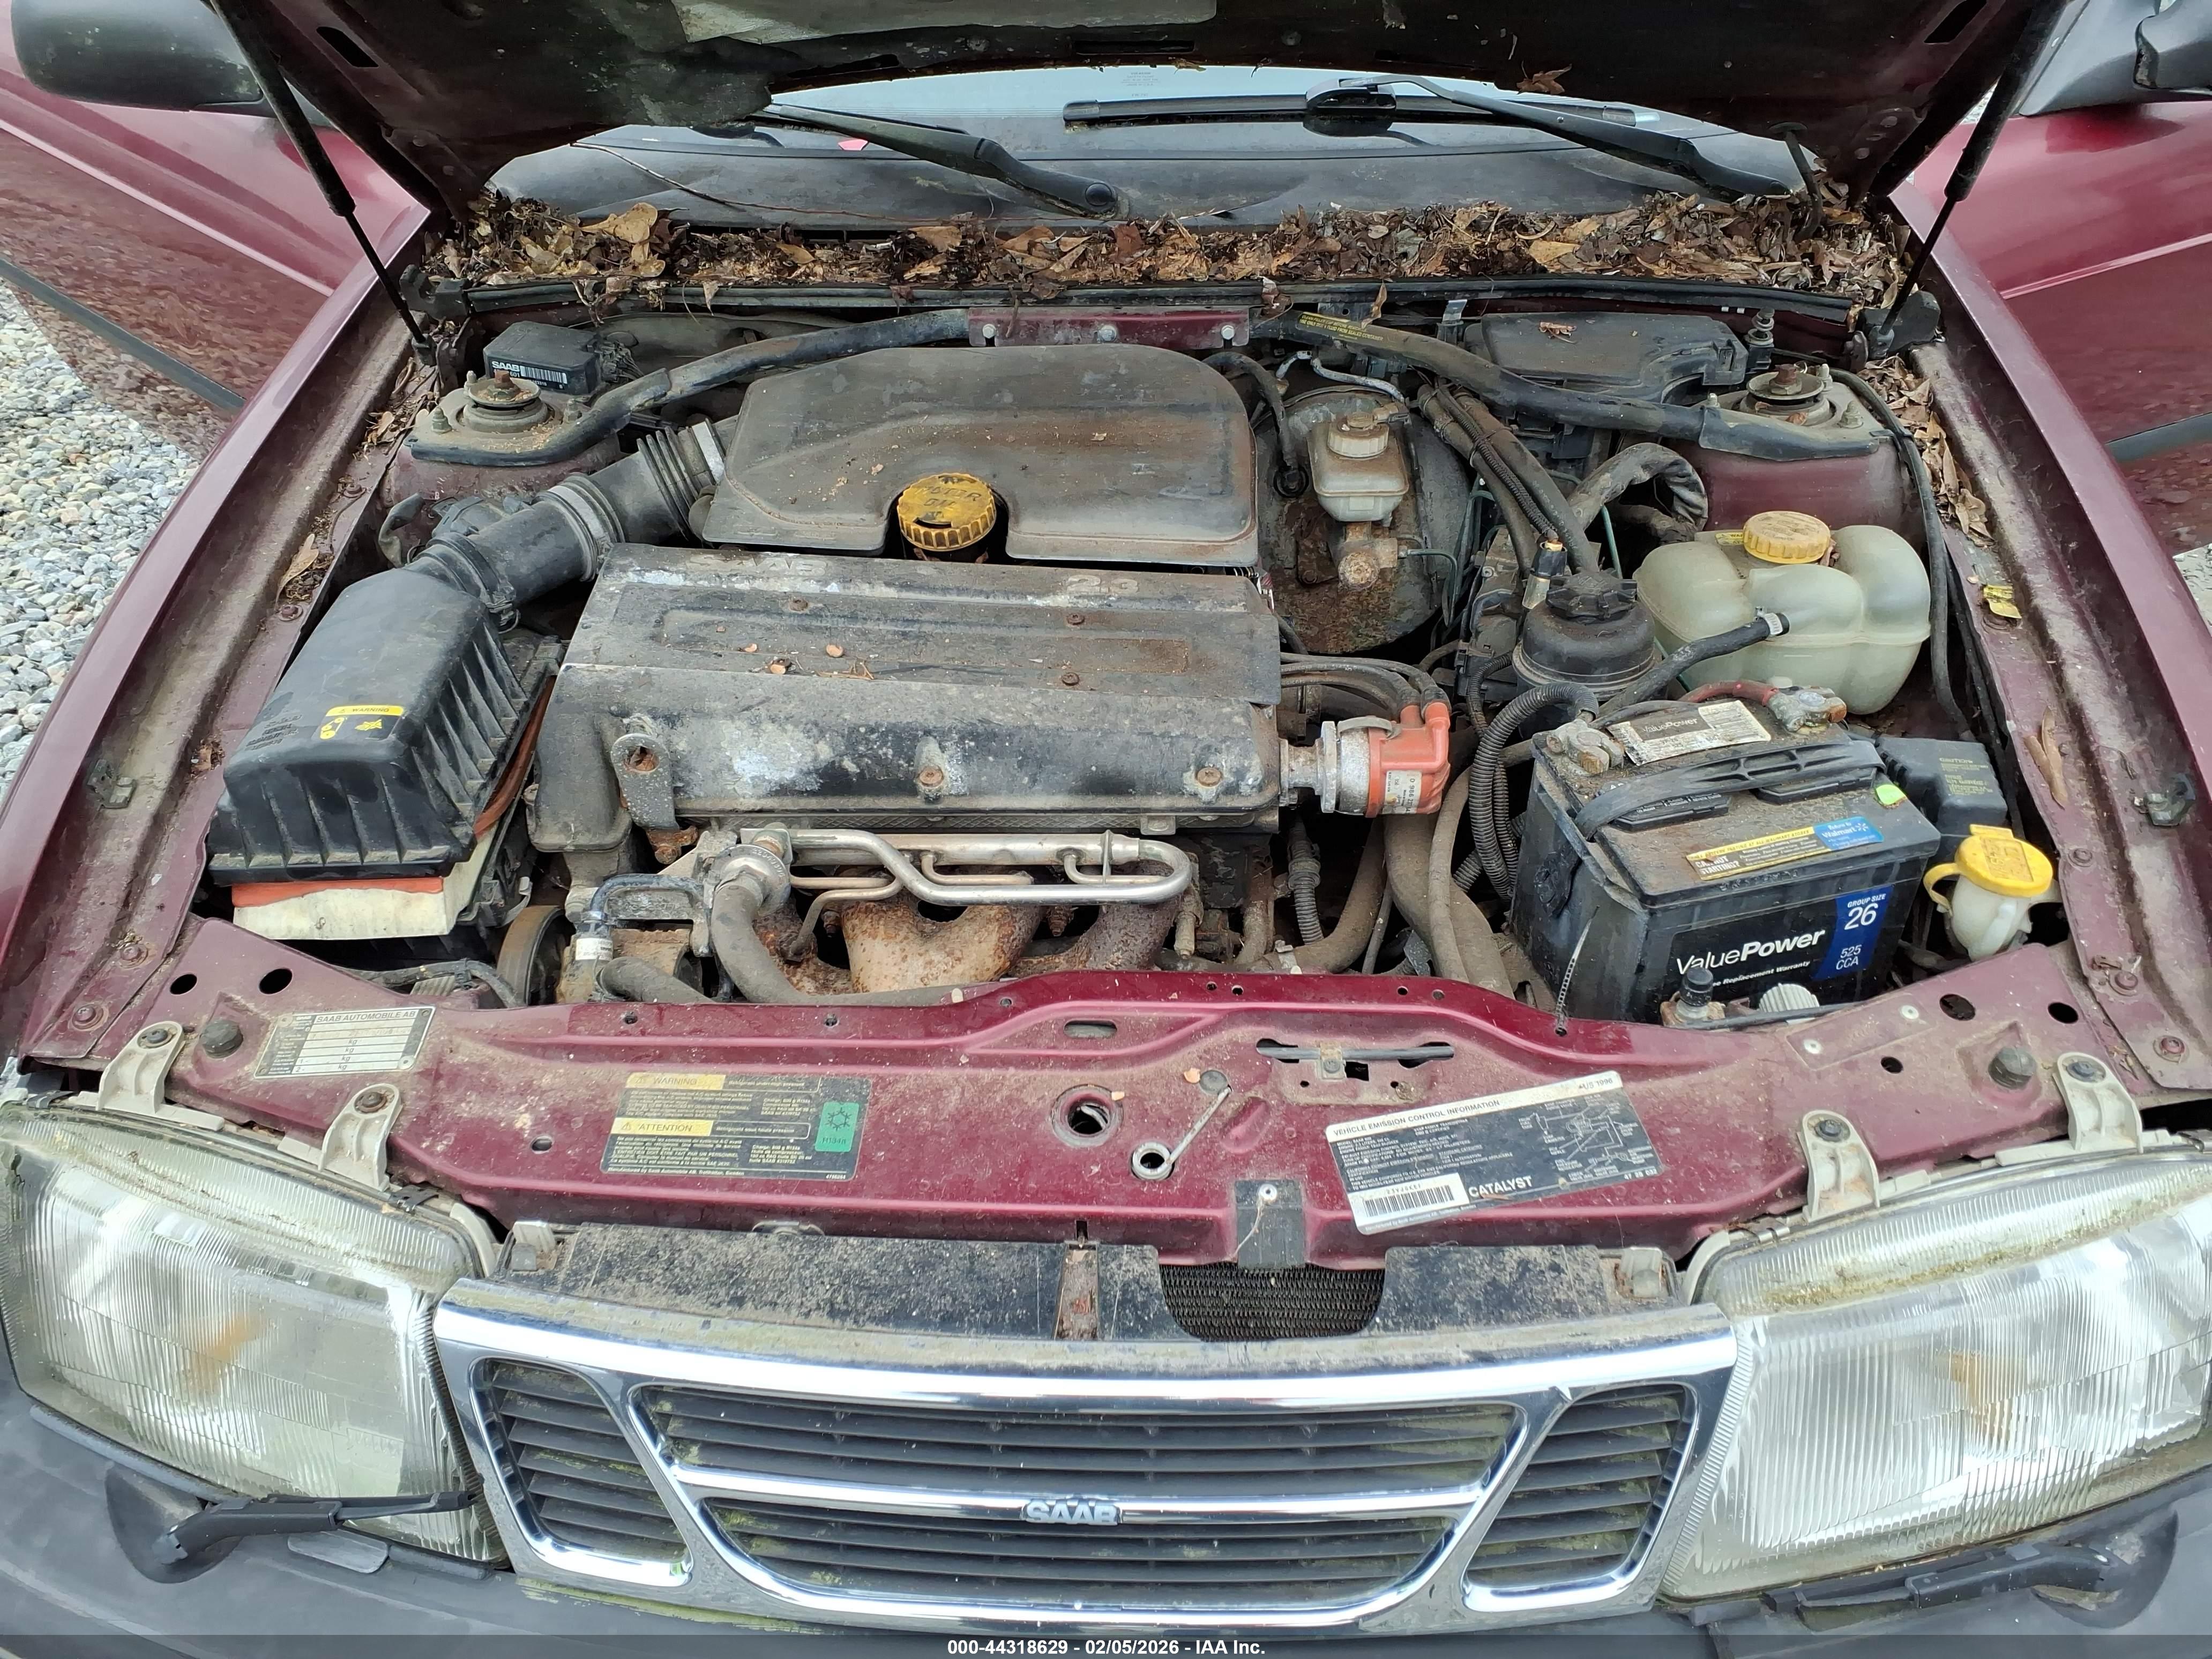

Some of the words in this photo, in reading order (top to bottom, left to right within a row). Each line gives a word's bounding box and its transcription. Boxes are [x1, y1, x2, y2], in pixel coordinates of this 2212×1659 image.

[492, 361, 520, 372] SAAB
[1066, 574, 1139, 594] 2.3
[1642, 718, 1698, 733] ValuePower
[1822, 827, 1857, 838] Walmart
[1699, 861, 1740, 875] STARTING?
[1848, 897, 1870, 908] GROUP
[1871, 893, 1886, 902] SIZE
[1844, 903, 1879, 930] 26
[1676, 930, 1826, 975] ValuePower
[1840, 944, 1862, 959] 525
[1835, 957, 1859, 970] CCA
[1723, 968, 1774, 985] Replacement
[1776, 960, 1810, 973] Warranty
[317, 1014, 342, 1023] SAAB
[343, 1011, 401, 1022] AUTOMOBILE
[1597, 1078, 1613, 1087] 1996
[1334, 1125, 1366, 1137] VEHICLE
[1368, 1118, 1406, 1130] EMISSION
[1409, 1110, 1445, 1122] CONTROL
[1447, 1100, 1500, 1114] INFORMATION
[1468, 1176, 1533, 1198] CATALYST
[1027, 1499, 1118, 1526] SAAB
